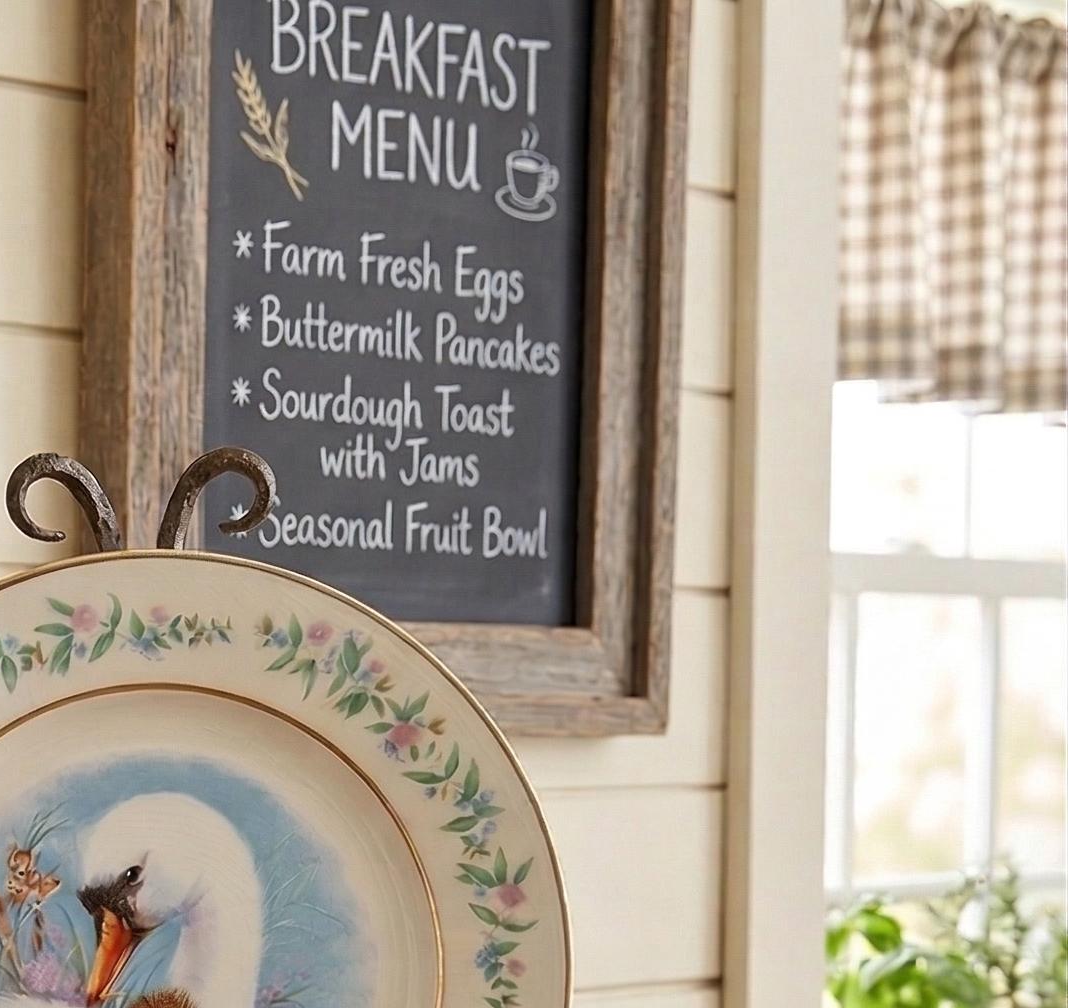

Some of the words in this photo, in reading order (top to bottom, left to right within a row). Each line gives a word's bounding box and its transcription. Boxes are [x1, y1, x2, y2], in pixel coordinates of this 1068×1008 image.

[270, 0, 551, 116] BREAKFAST
[331, 100, 482, 192] MENU
[262, 220, 347, 281] Farm
[360, 232, 443, 294] Fresh
[455, 246, 525, 324] Eggs
[260, 294, 423, 362] Buttermilk
[435, 312, 560, 376] Pancakes
[259, 367, 423, 451] Sourdough
[435, 385, 515, 437] Toast
[320, 433, 385, 480] with
[399, 437, 480, 488] Jams
[406, 502, 473, 555] Fruit
[483, 506, 548, 559] Bowl
